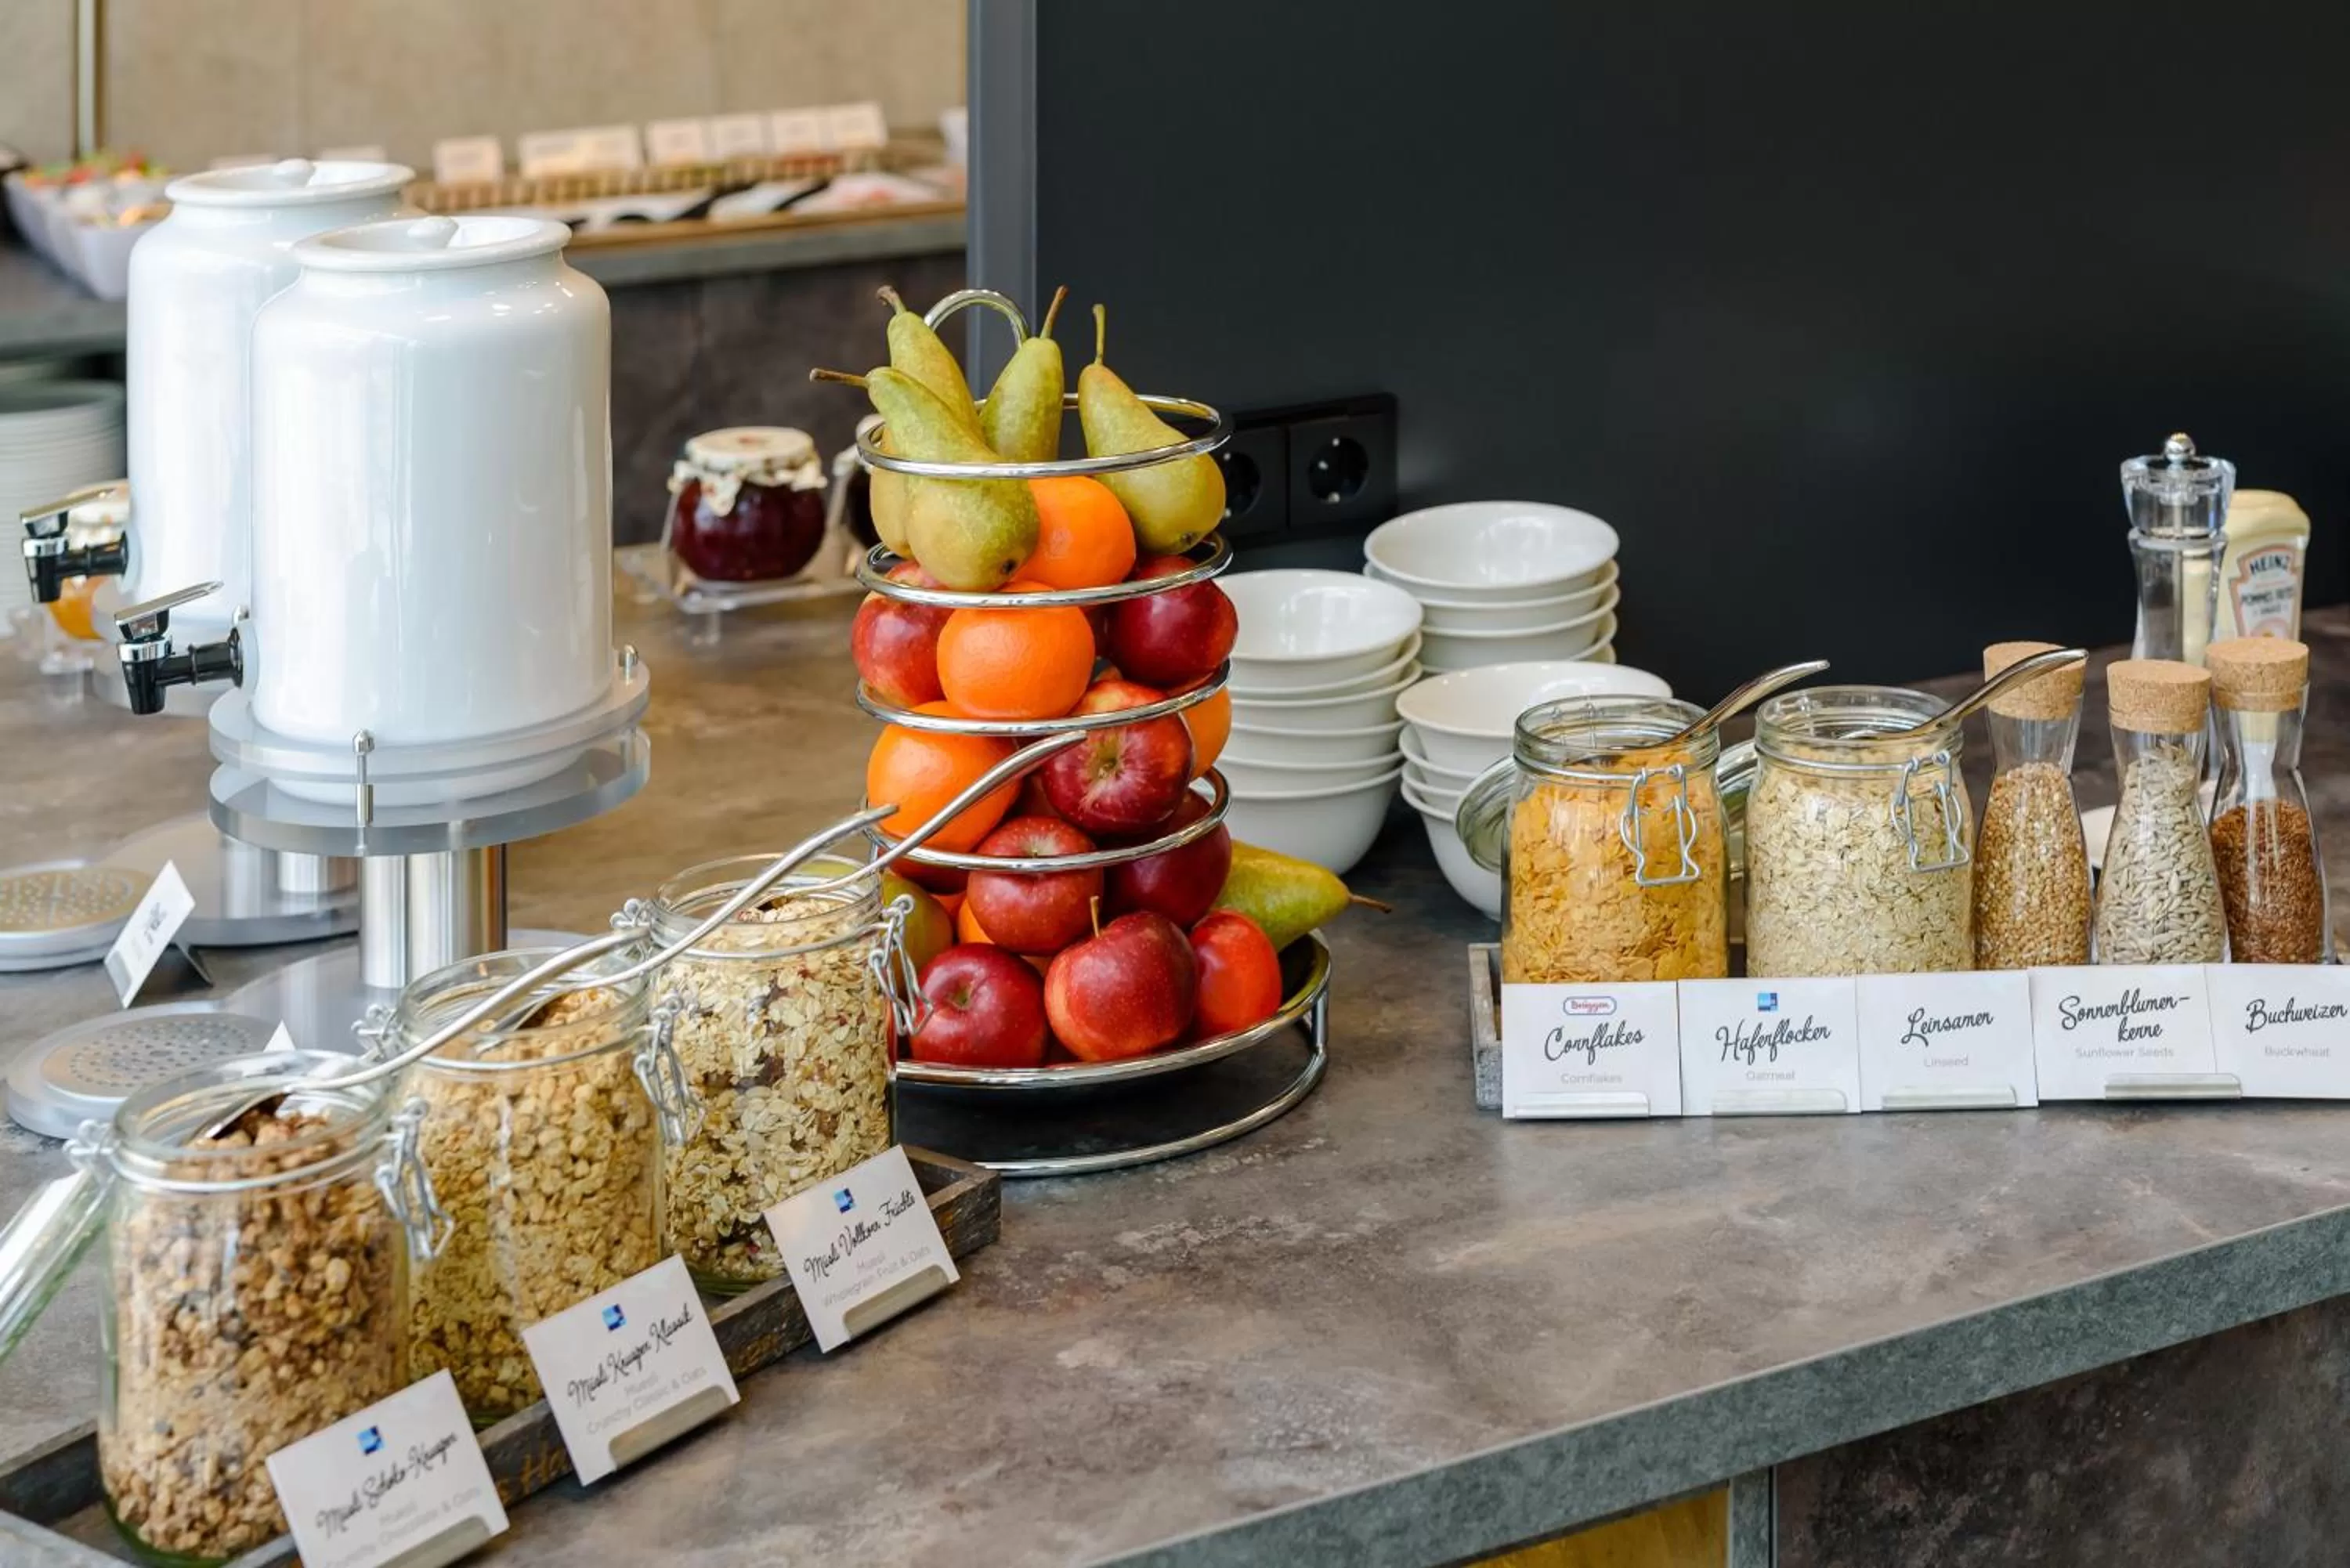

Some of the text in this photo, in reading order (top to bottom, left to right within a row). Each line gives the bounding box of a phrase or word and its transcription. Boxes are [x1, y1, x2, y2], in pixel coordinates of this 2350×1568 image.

[2250, 555, 2291, 575] HEINZ
[2058, 988, 2191, 1031] Sonnenblumen-
[2245, 996, 2348, 1033] Buchweizen
[1544, 1020, 1645, 1065] Cornflakes
[1715, 1014, 1831, 1065] Haferflocken
[1900, 1007, 1994, 1047] Leinsamen
[2117, 1017, 2163, 1042] kerne
[1924, 1055, 1969, 1067] Linseed
[2076, 1047, 2135, 1057] Sunflower
[1560, 1072, 1622, 1084] Cornflakes
